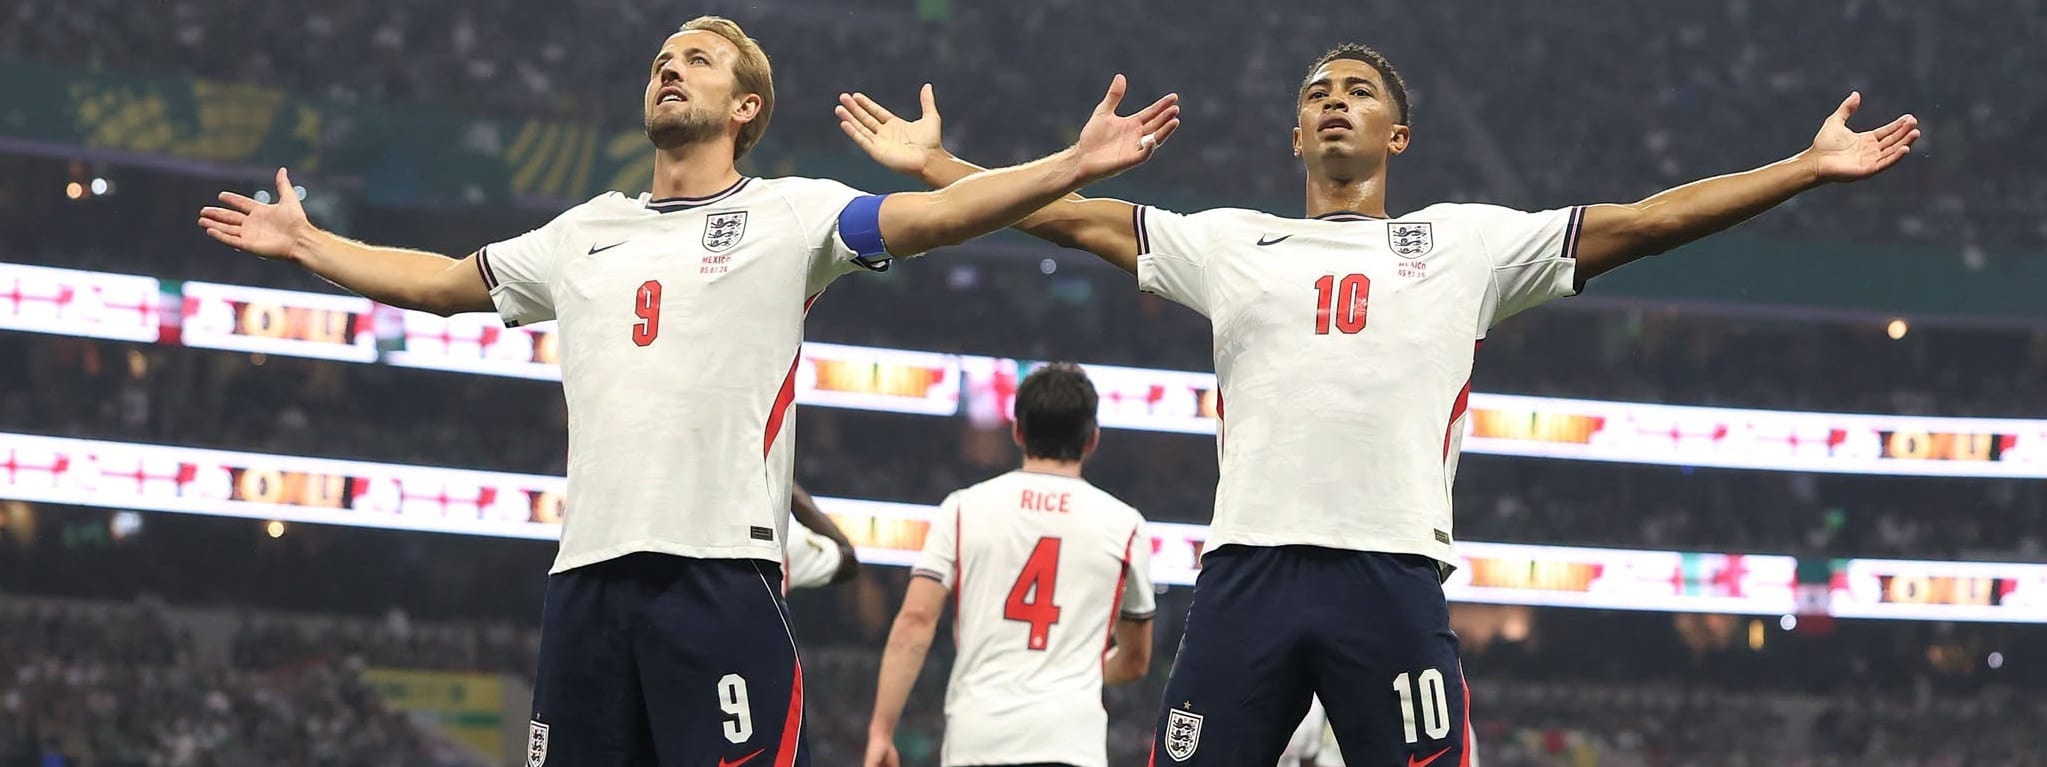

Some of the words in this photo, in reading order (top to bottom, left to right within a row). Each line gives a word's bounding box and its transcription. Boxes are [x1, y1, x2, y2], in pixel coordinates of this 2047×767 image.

[702, 255, 731, 264] MEXICO
[632, 280, 662, 347] 9
[1314, 273, 1370, 335] 10
[1020, 489, 1072, 513] RICE
[1004, 536, 1061, 651] 4
[717, 673, 753, 744] 9
[1392, 668, 1451, 744] 10
